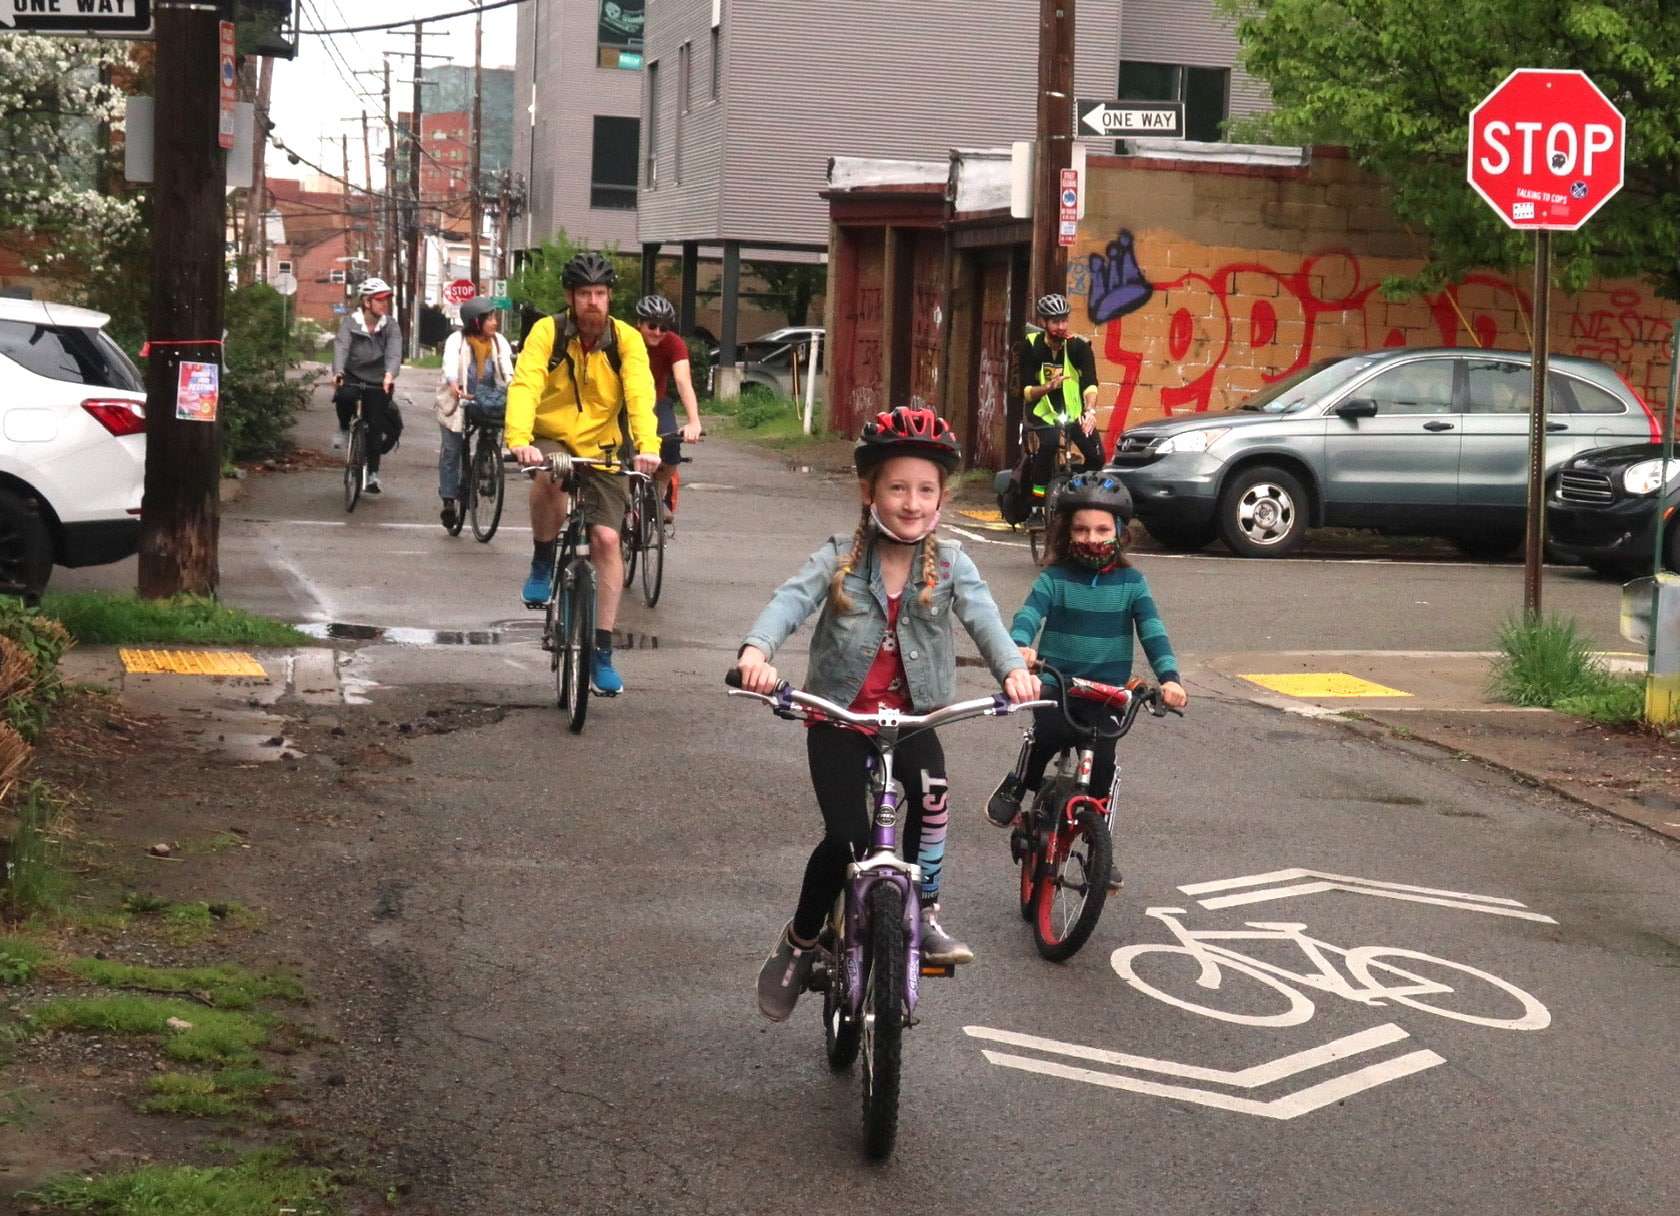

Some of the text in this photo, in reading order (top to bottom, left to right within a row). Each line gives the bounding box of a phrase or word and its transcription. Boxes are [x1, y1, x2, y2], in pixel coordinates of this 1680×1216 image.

[77, 0, 124, 13] WAY
[1102, 112, 1172, 127] ONE WAY
[1480, 120, 1615, 177] STOP
[1551, 193, 1568, 205] COPS
[451, 286, 473, 296] STOP
